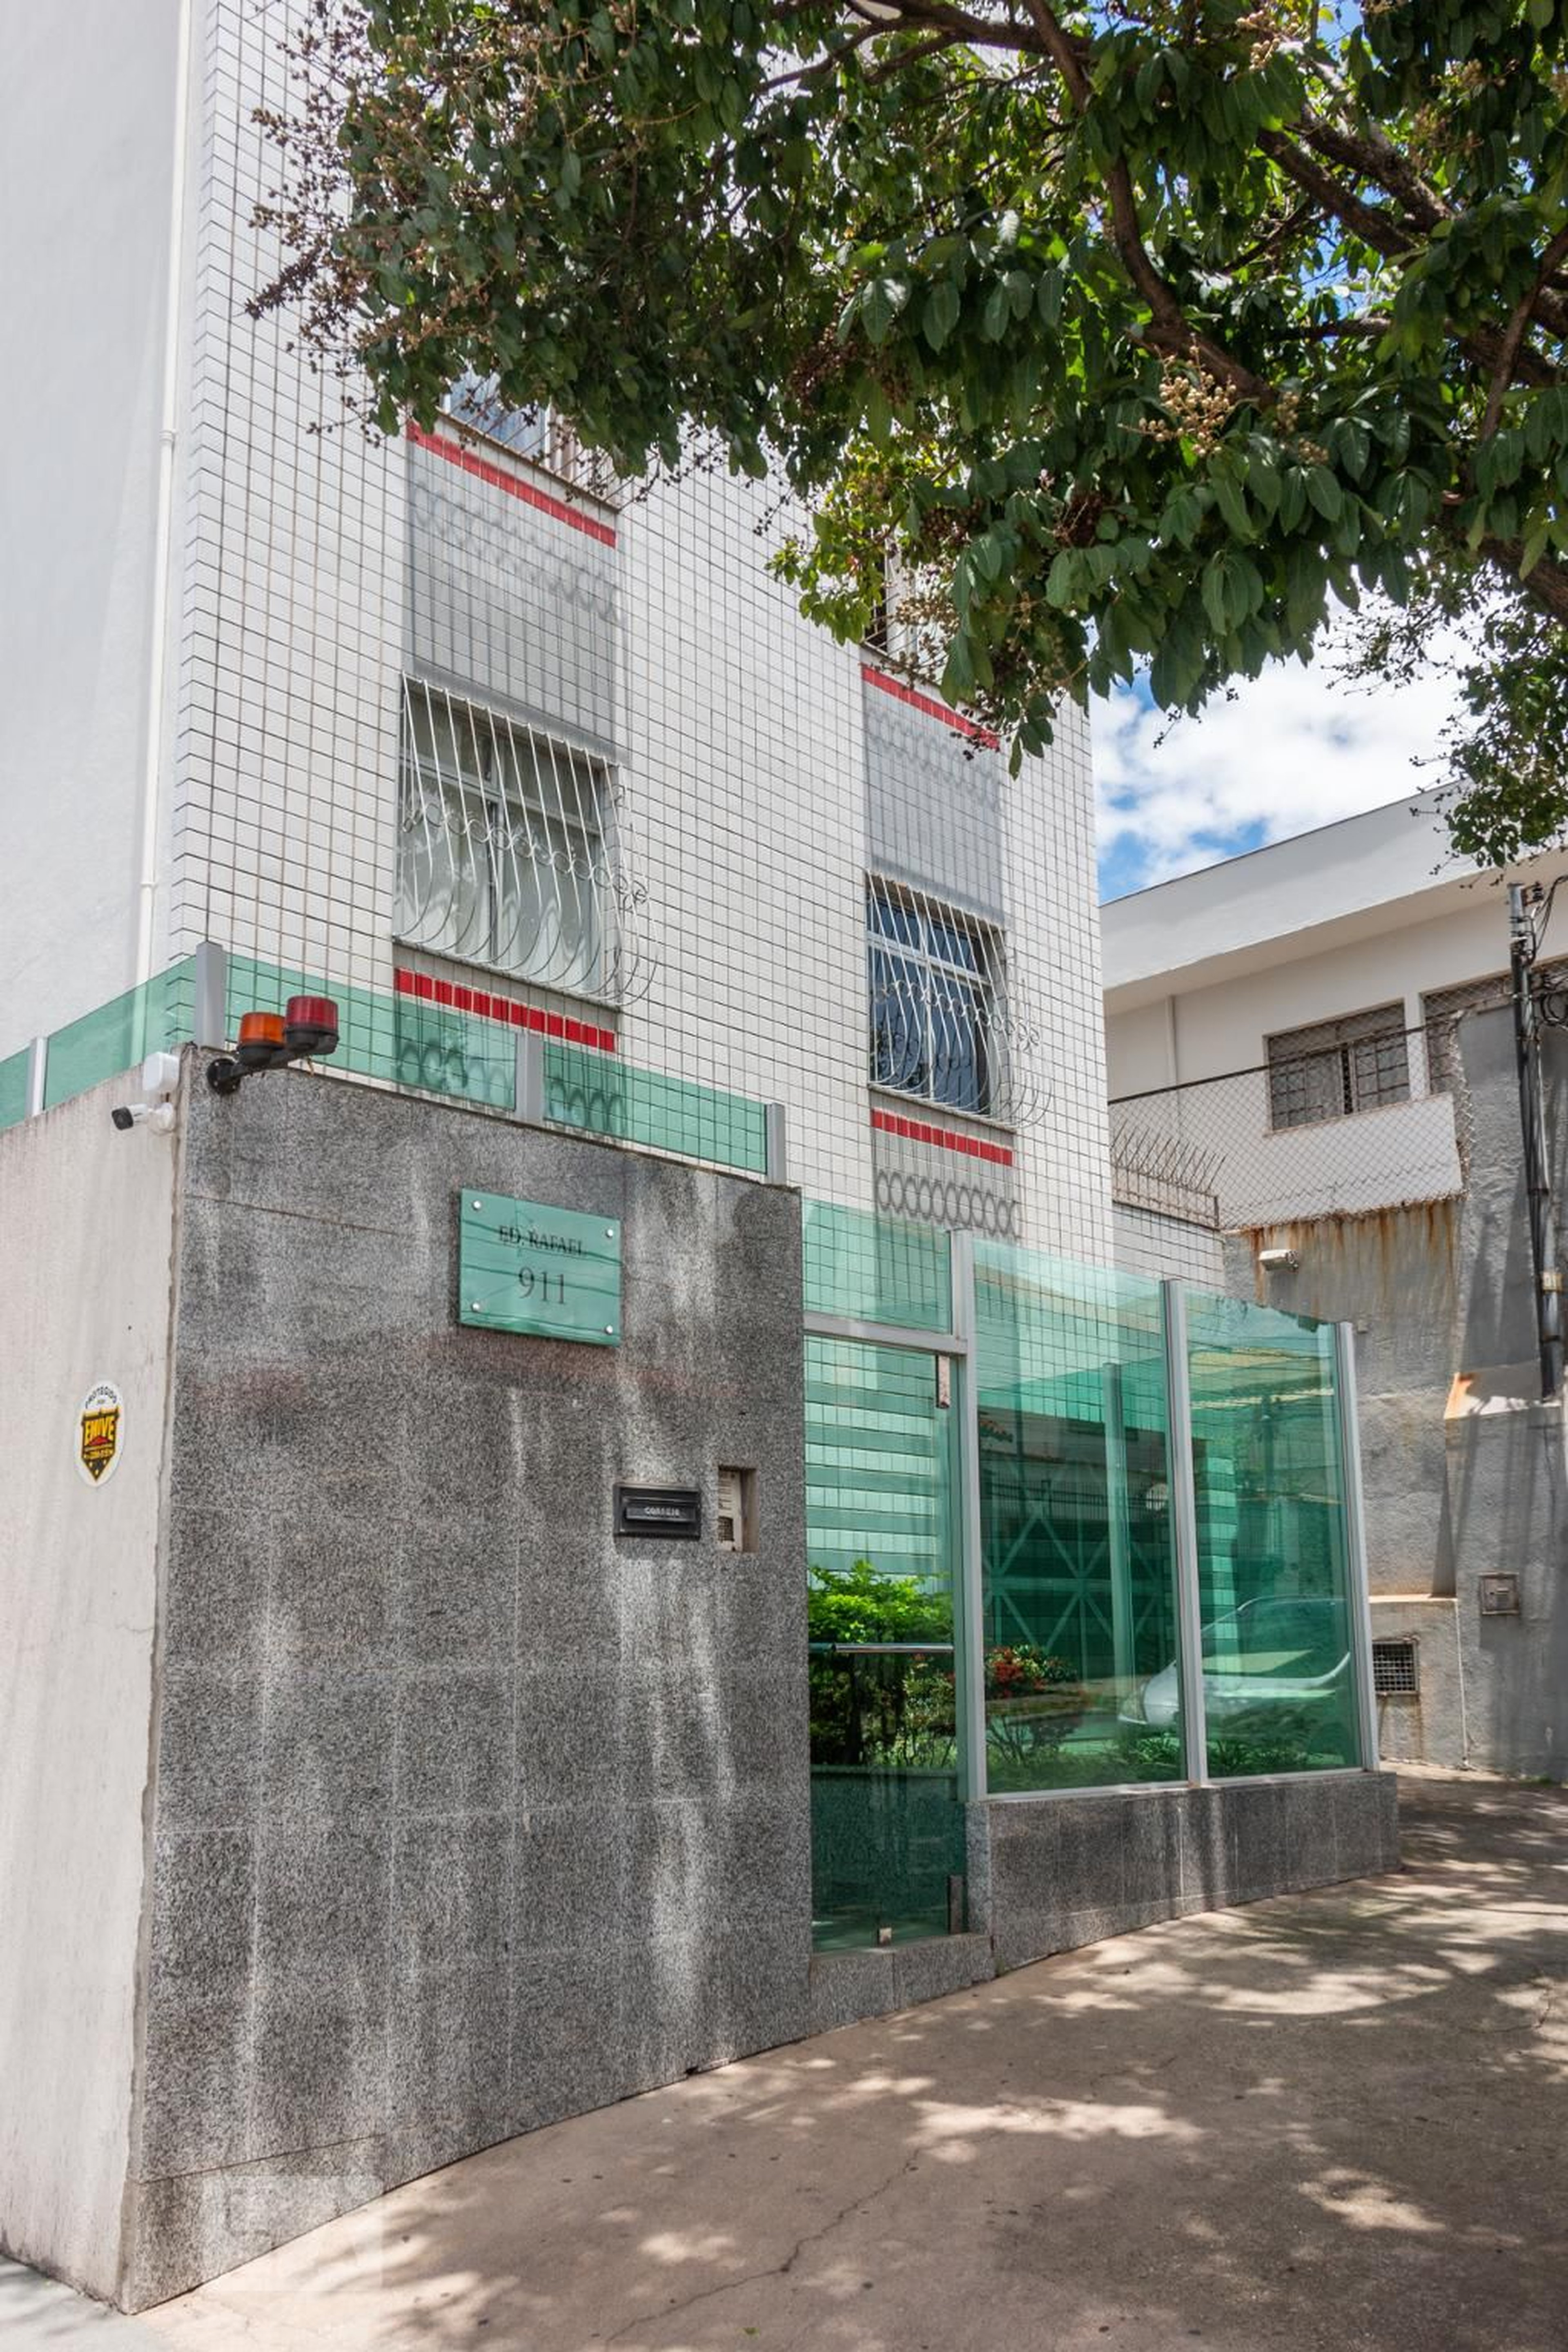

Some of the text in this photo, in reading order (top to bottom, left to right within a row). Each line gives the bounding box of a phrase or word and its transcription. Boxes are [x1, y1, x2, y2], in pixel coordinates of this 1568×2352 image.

[499, 1225, 586, 1256] ED. RAFAEL
[519, 1266, 567, 1305] 911
